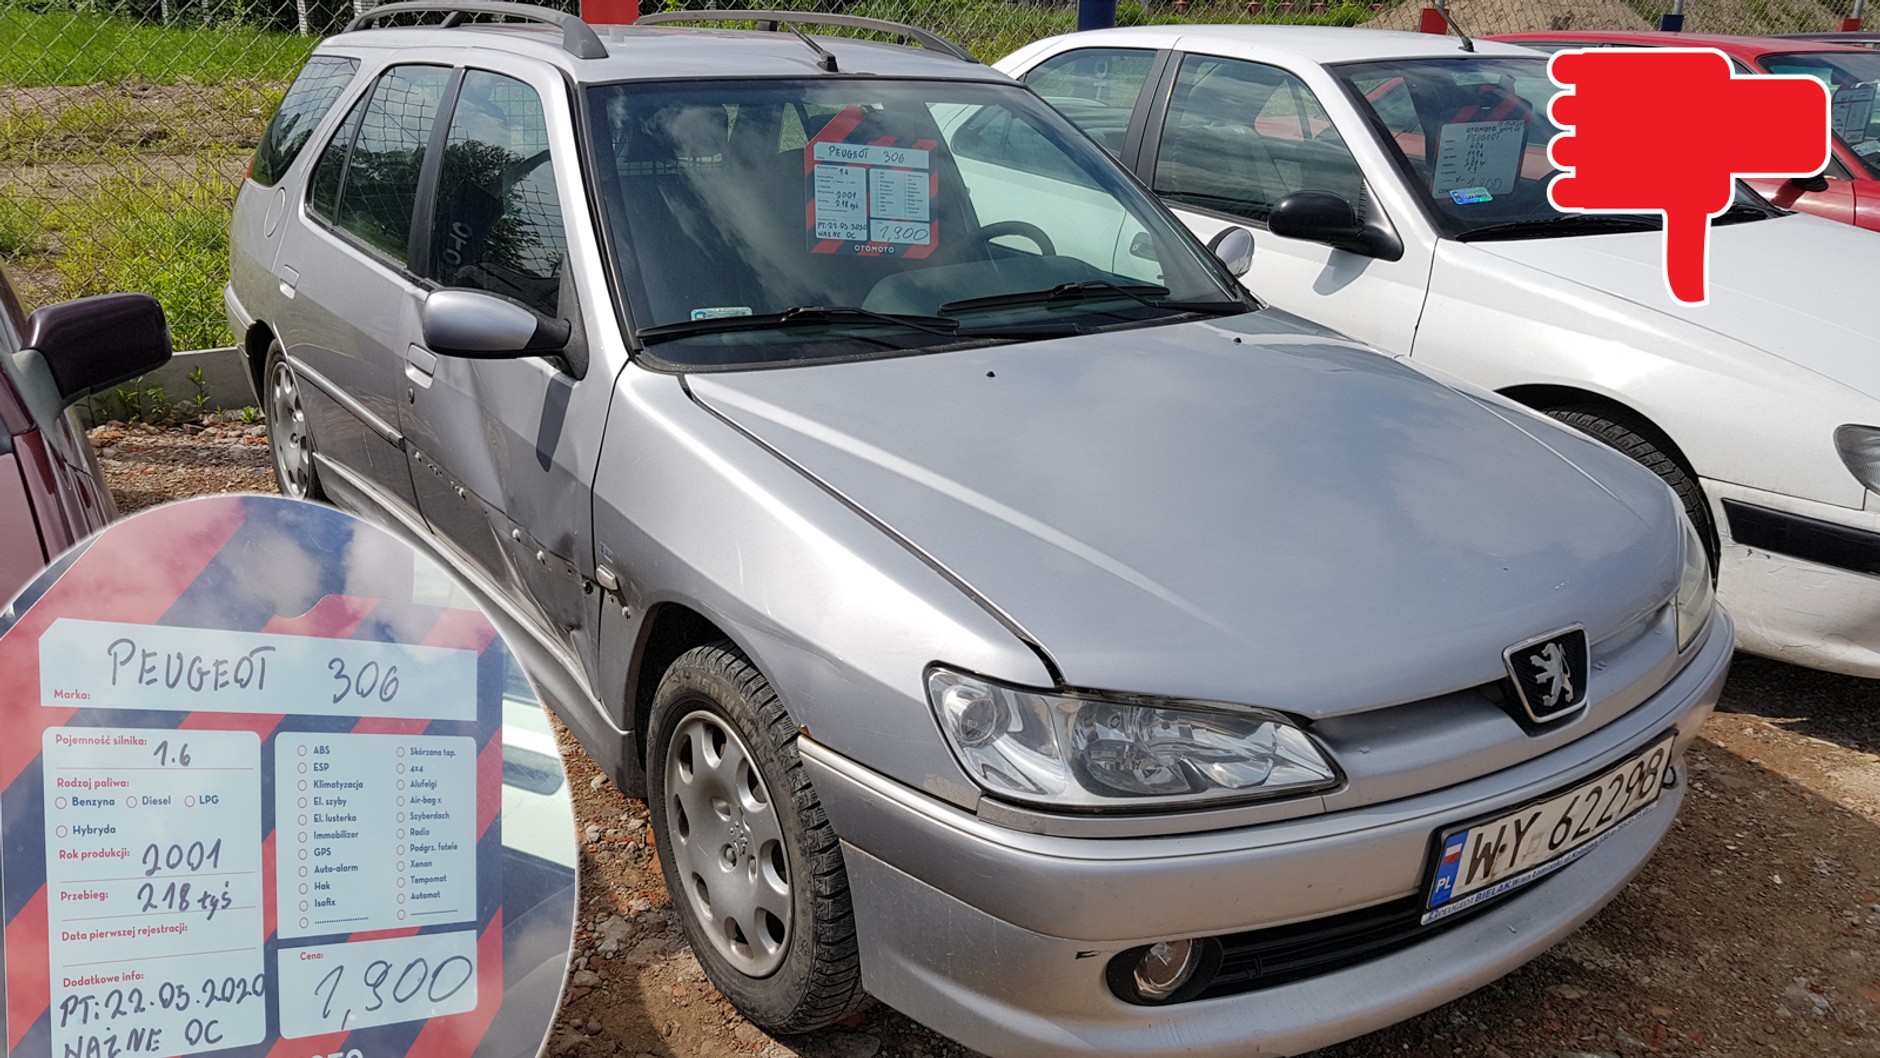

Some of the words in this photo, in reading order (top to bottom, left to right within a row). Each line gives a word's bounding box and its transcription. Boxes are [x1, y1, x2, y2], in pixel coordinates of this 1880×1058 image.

[828, 146, 870, 159] PEUGEOT
[883, 151, 905, 163] 306
[854, 244, 894, 253] OTOMOTO
[107, 638, 276, 692] PEUGEOT
[327, 657, 400, 704] 306
[54, 688, 91, 700] Marka:
[55, 734, 111, 747] Pojemność
[113, 735, 148, 747] silnika:
[152, 740, 192, 767] 1.6
[313, 745, 330, 755] ABS
[410, 747, 442, 757] Skórzana
[313, 763, 330, 772] ESP
[410, 765, 424, 773] 4x4
[57, 777, 93, 790] Rodzaj
[94, 778, 130, 791] paliwa:
[313, 780, 364, 790] Klimatyzacja
[410, 780, 437, 790] Alufelgi
[72, 796, 116, 808] Benzyna
[142, 795, 172, 806] Diesel
[199, 795, 220, 805] LPG
[313, 797, 324, 806] El.
[325, 797, 347, 808] szyby
[410, 796, 436, 806] Air-bag
[1548, 747, 1665, 851] 62298
[314, 814, 324, 823] El.
[325, 814, 357, 822] lusterka
[410, 812, 450, 822] Szyberdach
[72, 824, 117, 837] Hybryda
[314, 830, 359, 840] Immobilizer
[410, 827, 430, 836] Radio
[314, 847, 331, 856] GPS
[410, 844, 437, 854] Podgrz.
[438, 843, 458, 851] fotele
[59, 849, 79, 860] Rok
[80, 848, 131, 862] produkcji:
[142, 838, 222, 877] 2001
[314, 864, 359, 874] Auto-alarm
[410, 860, 433, 868] Xenon
[410, 875, 447, 885] Tempomat
[1435, 876, 1452, 894] PL
[314, 882, 331, 891] Hak
[60, 890, 109, 903] Przebieg:
[137, 881, 191, 913] 218
[411, 891, 441, 900] Automat
[1475, 881, 1511, 903] BIELAK
[314, 898, 336, 908] Isofix
[61, 931, 87, 942] Data
[89, 927, 136, 941] pierwszej
[137, 923, 189, 937] rejestracji:
[299, 951, 325, 961] Cena:
[63, 974, 120, 988] Dodatkowe
[121, 971, 145, 983] info:
[184, 1018, 223, 1046] OC
